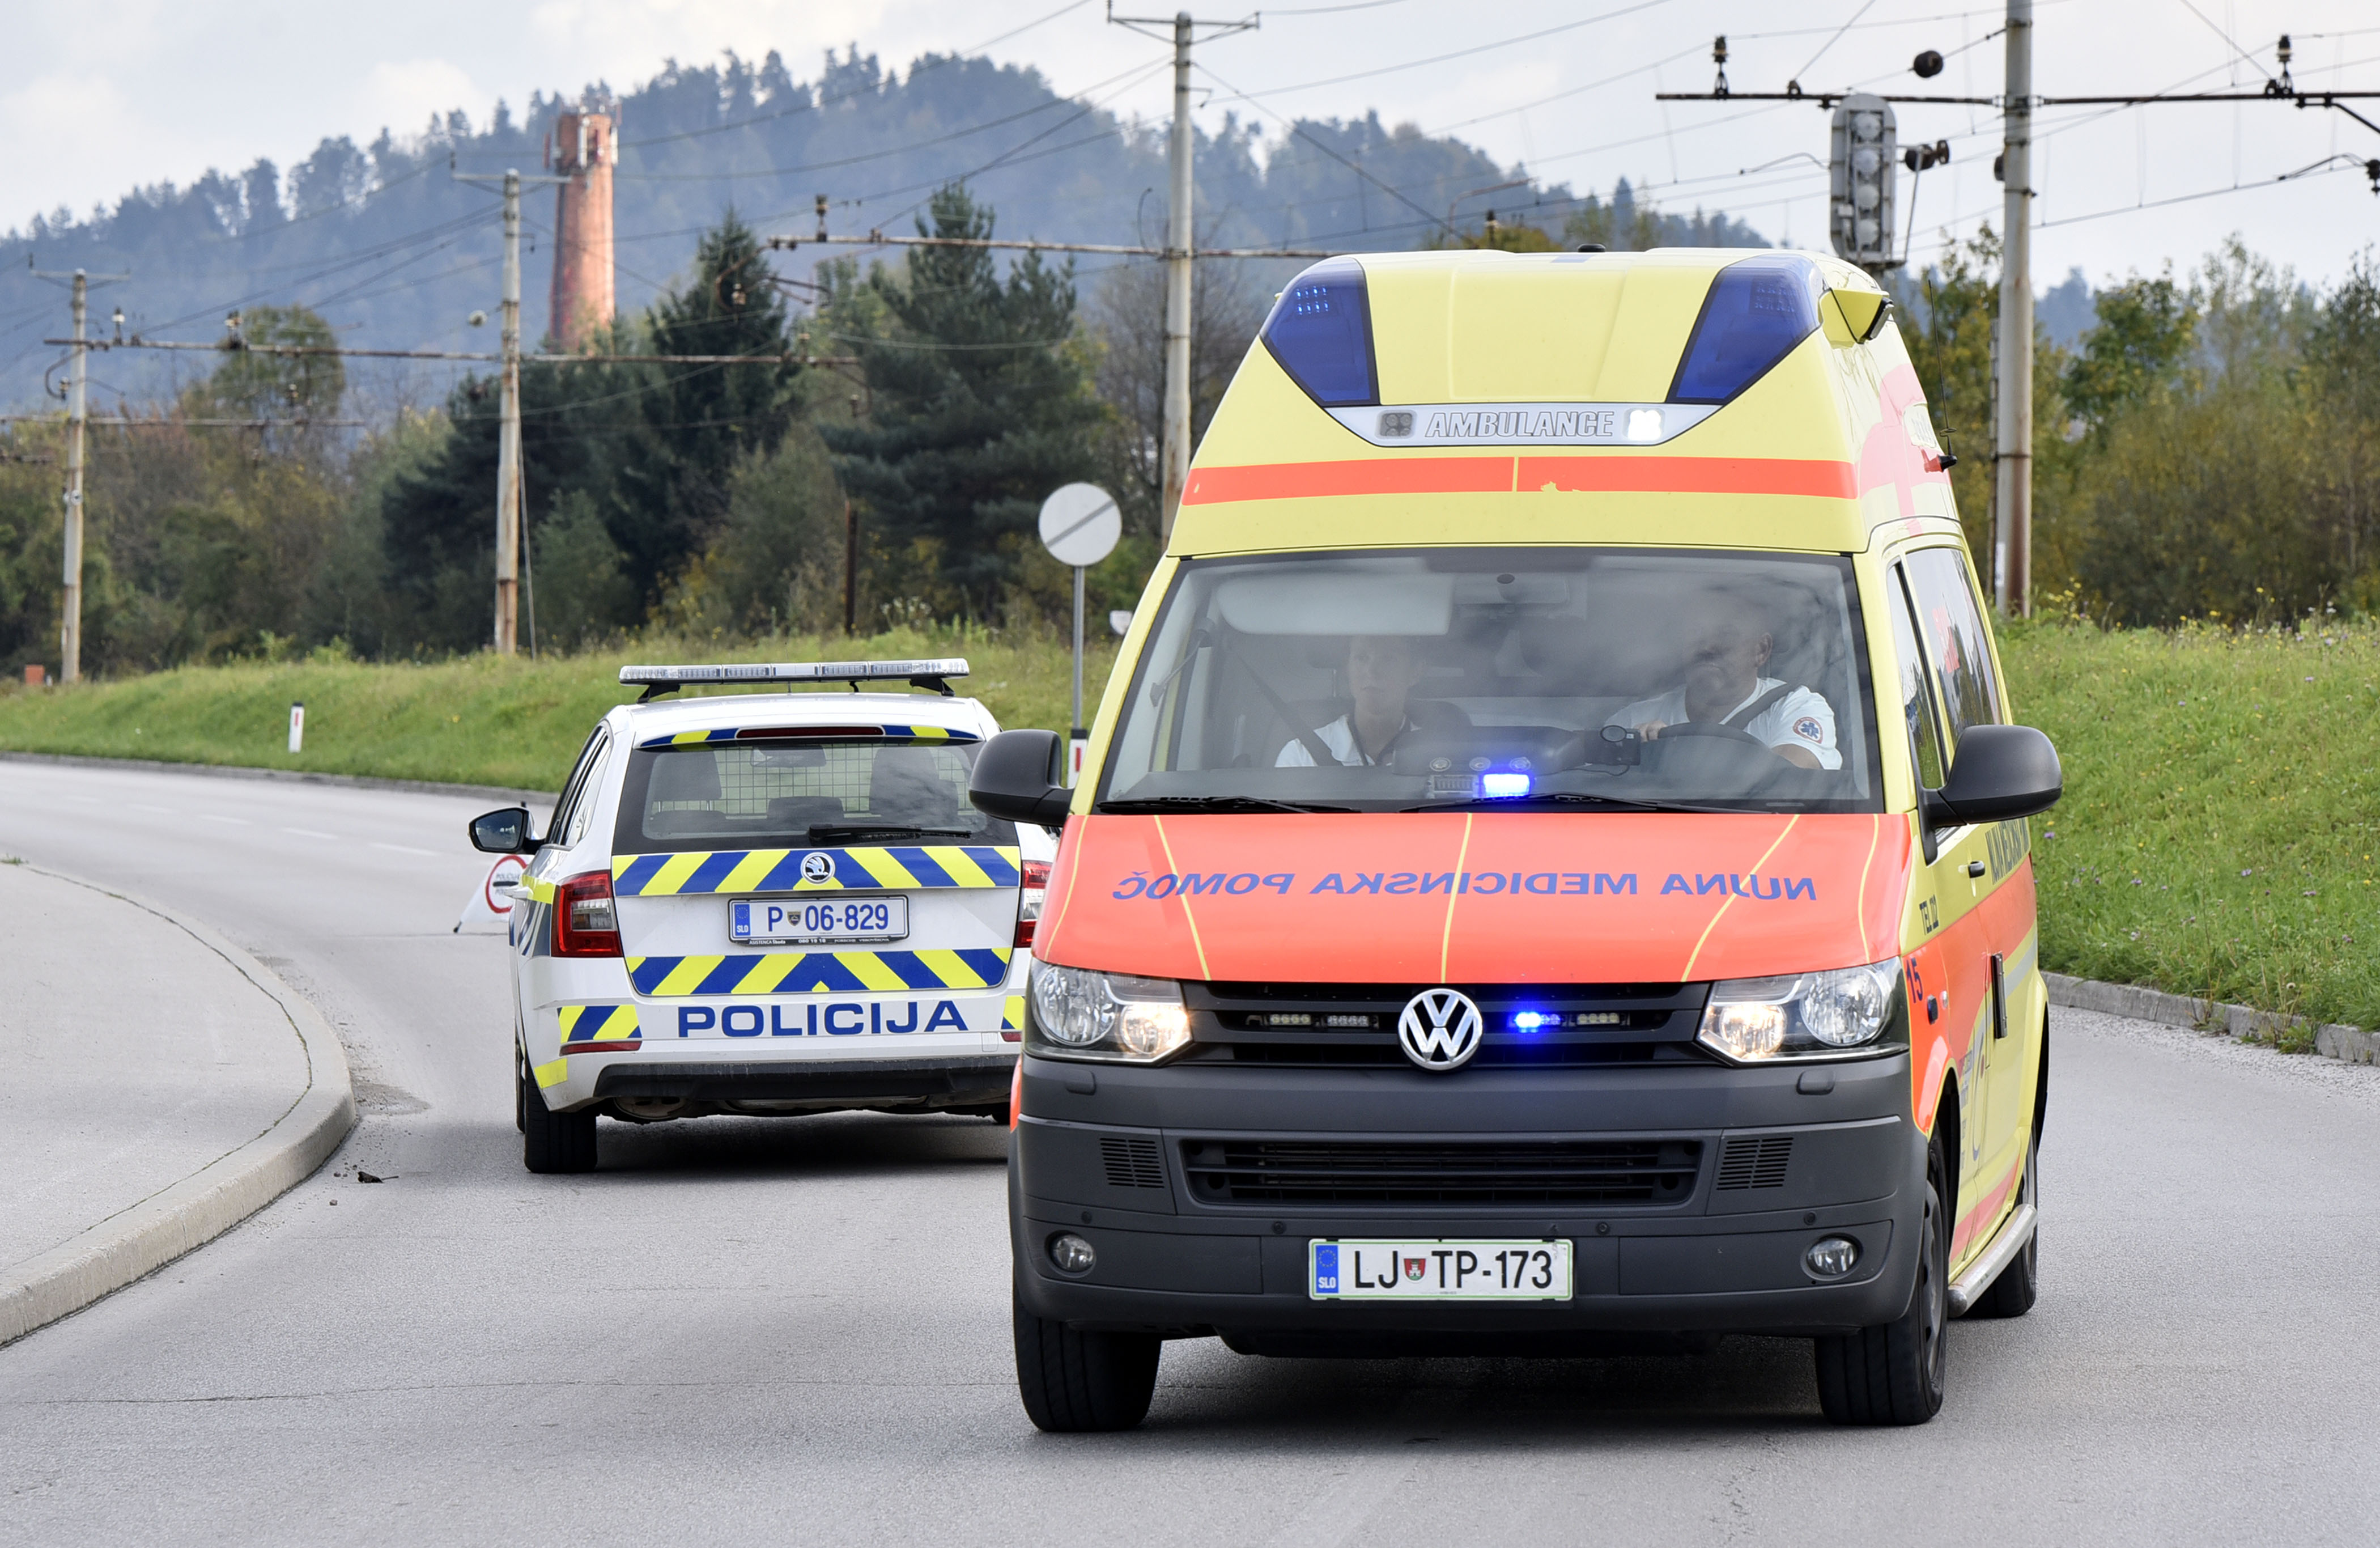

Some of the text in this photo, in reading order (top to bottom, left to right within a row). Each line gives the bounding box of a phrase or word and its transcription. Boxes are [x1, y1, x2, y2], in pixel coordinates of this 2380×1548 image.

[1425, 412, 1614, 437] AMBULANCE
[737, 924, 749, 933] SLO
[767, 904, 889, 932] P 06-829
[1906, 957, 1923, 1003] 15
[678, 1000, 968, 1038] POLICIJA
[1318, 1276, 1336, 1288] SLO
[1354, 1250, 1552, 1288] LJ TP-173
